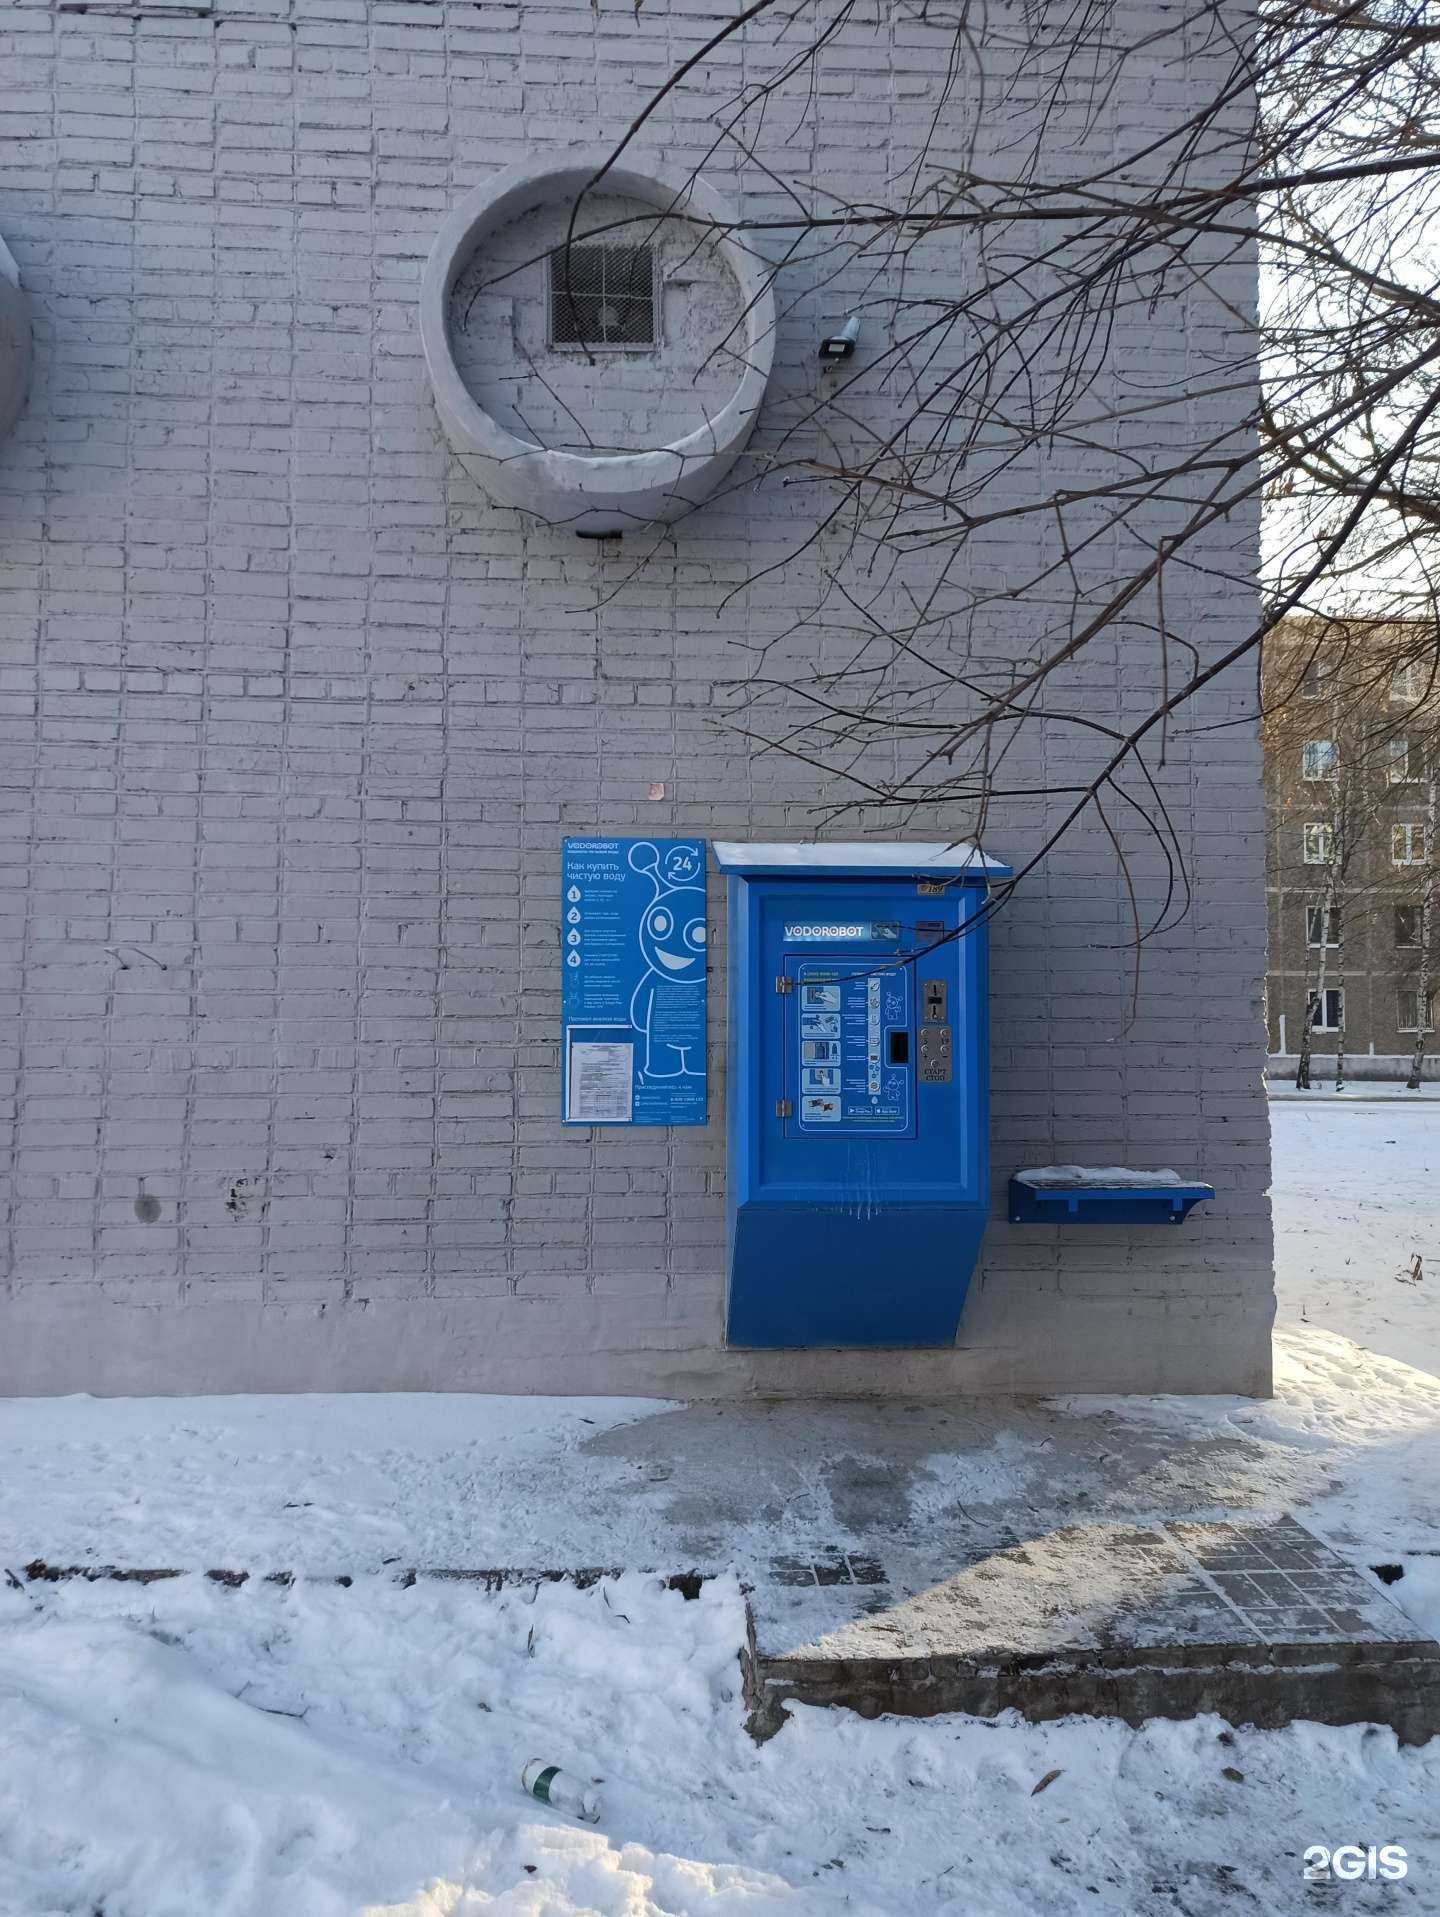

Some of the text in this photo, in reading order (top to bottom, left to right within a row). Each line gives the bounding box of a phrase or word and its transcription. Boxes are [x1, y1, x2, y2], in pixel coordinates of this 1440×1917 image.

[567, 861, 620, 872] Как купить
[672, 856, 692, 871] 24
[567, 873, 626, 882] чистую воду
[784, 926, 864, 937] VODOROBOT
